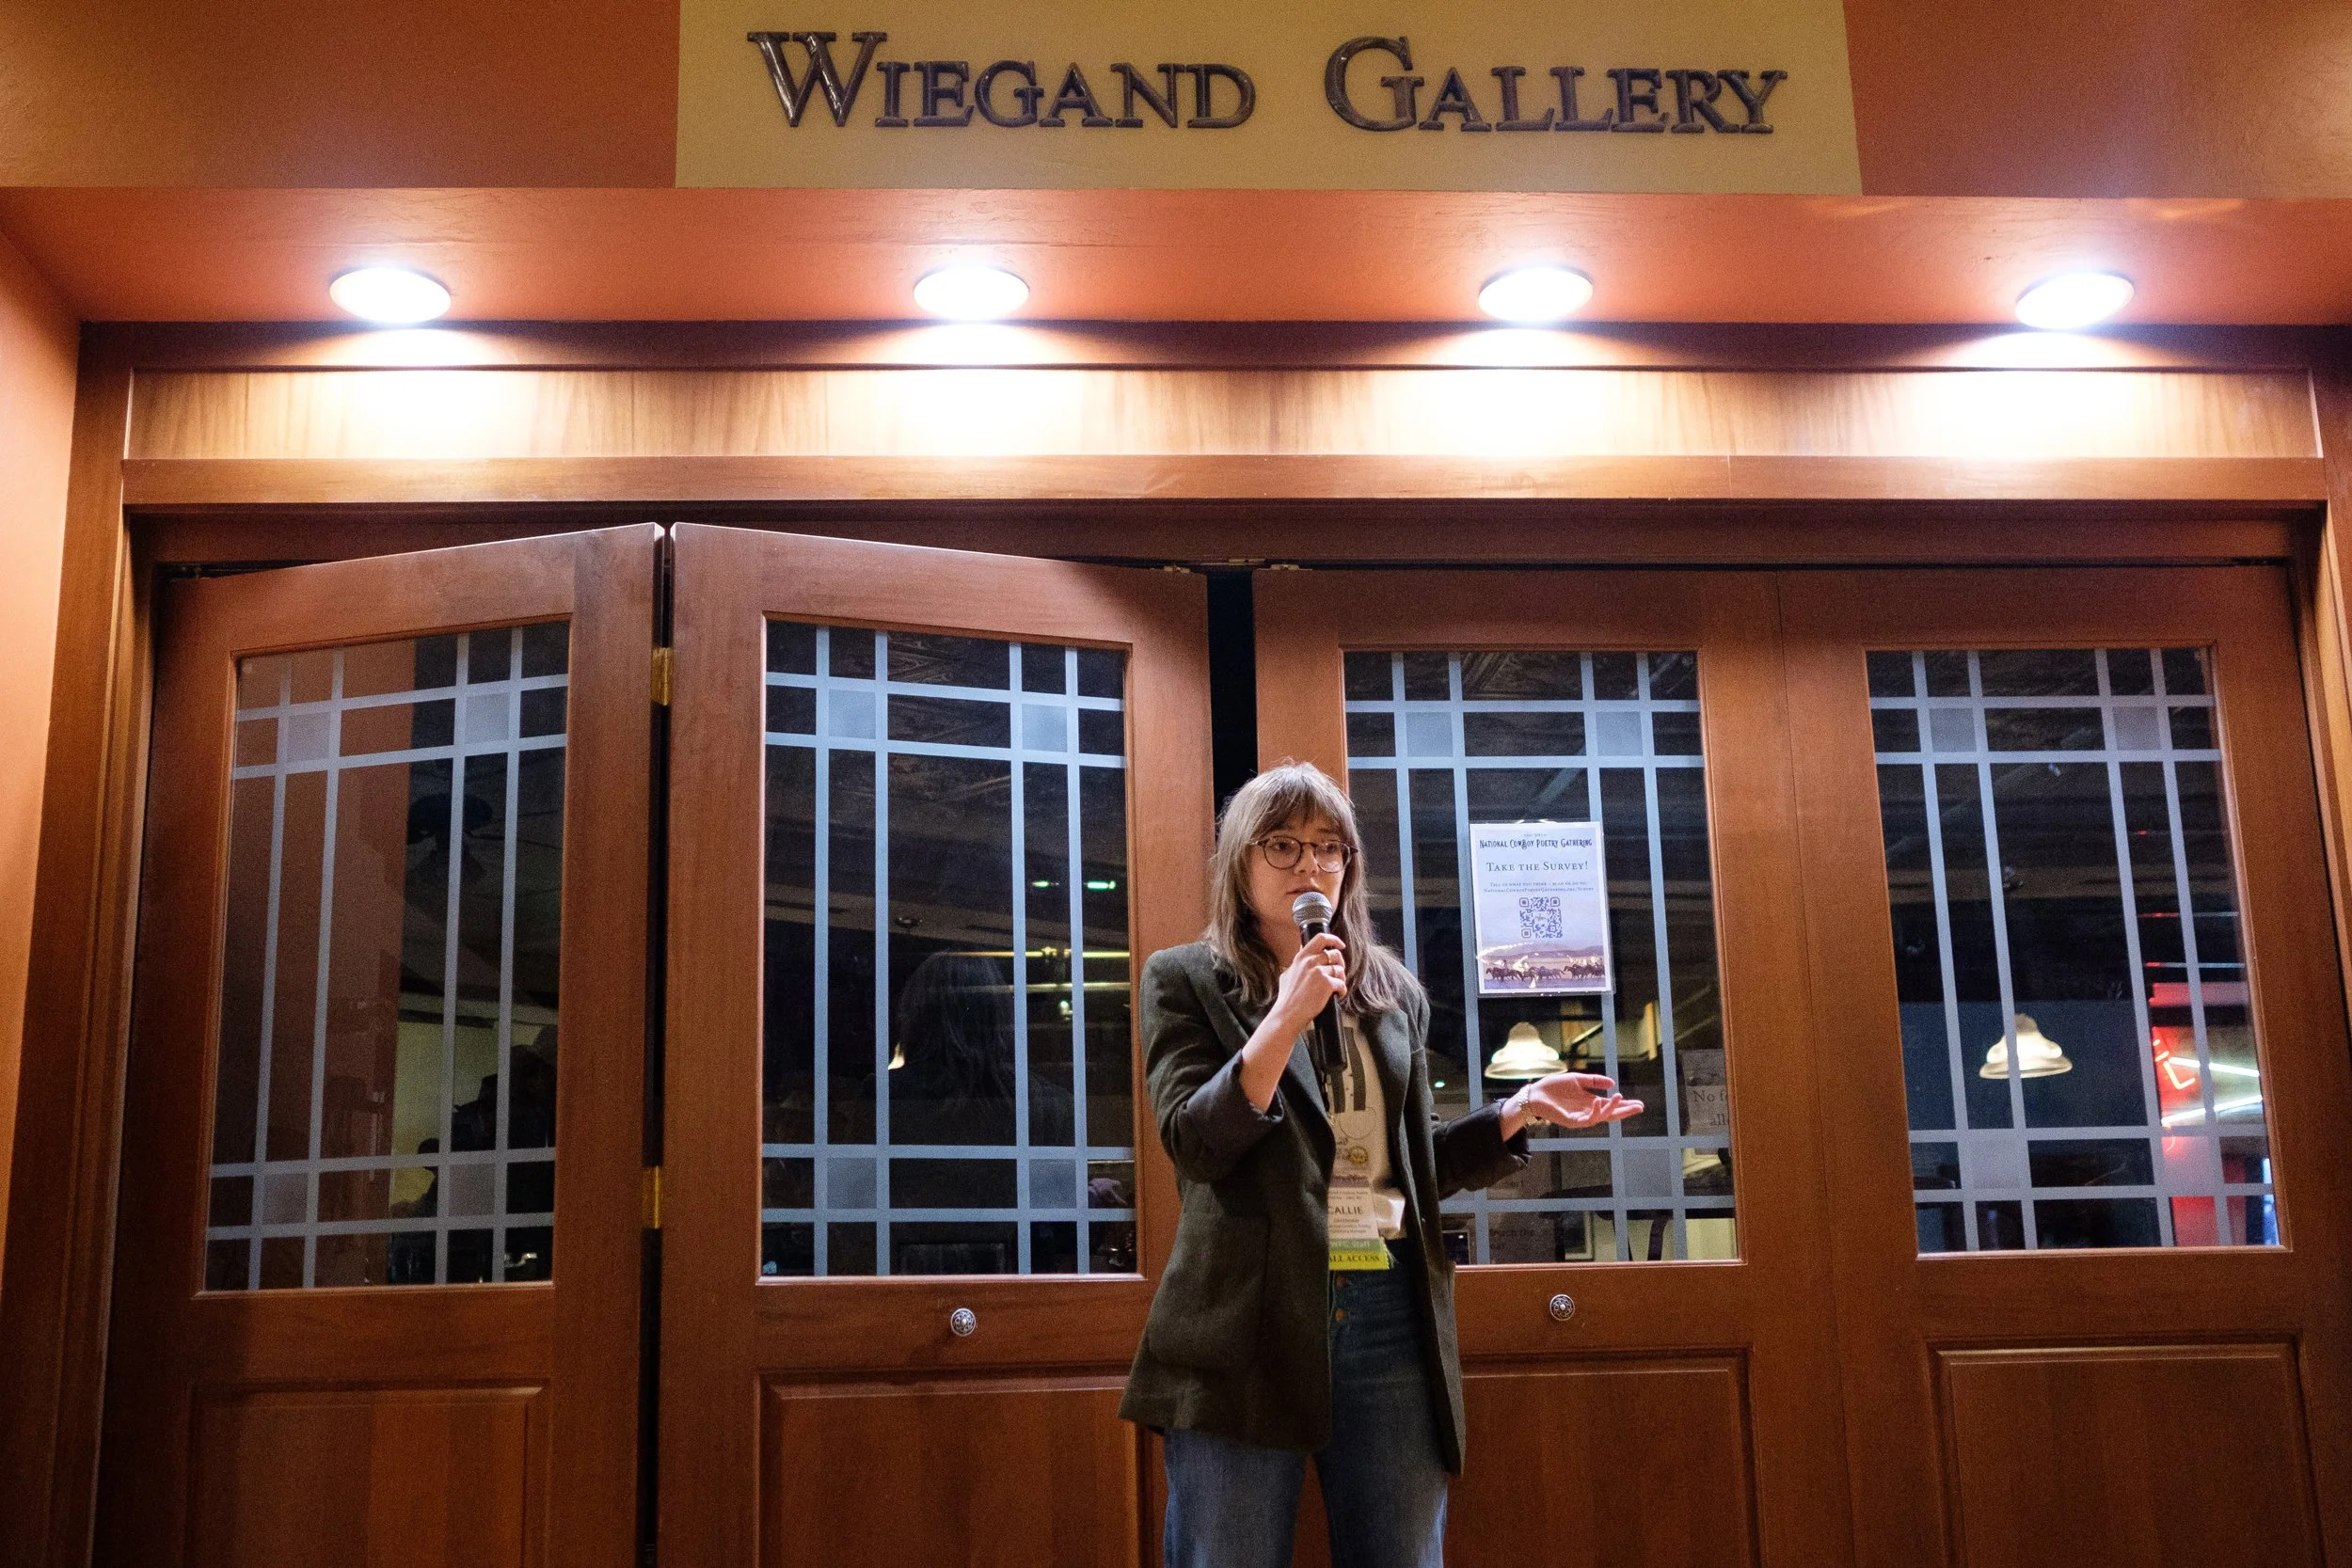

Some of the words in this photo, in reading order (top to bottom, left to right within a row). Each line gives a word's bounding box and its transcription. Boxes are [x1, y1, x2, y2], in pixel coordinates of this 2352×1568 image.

[747, 30, 1257, 130] WIEGAND
[1324, 35, 1789, 135] GALLERY
[1479, 839, 1507, 848] NATIONAL
[1509, 839, 1534, 850] COWBOY
[1536, 838, 1559, 848] POETRY
[1561, 838, 1593, 847] GATHERING
[1486, 862, 1515, 872] TAKE
[1518, 863, 1540, 871] THE
[1543, 861, 1589, 871] SURVEY!
[1692, 1090, 1715, 1102] No
[1709, 1114, 1729, 1126] all
